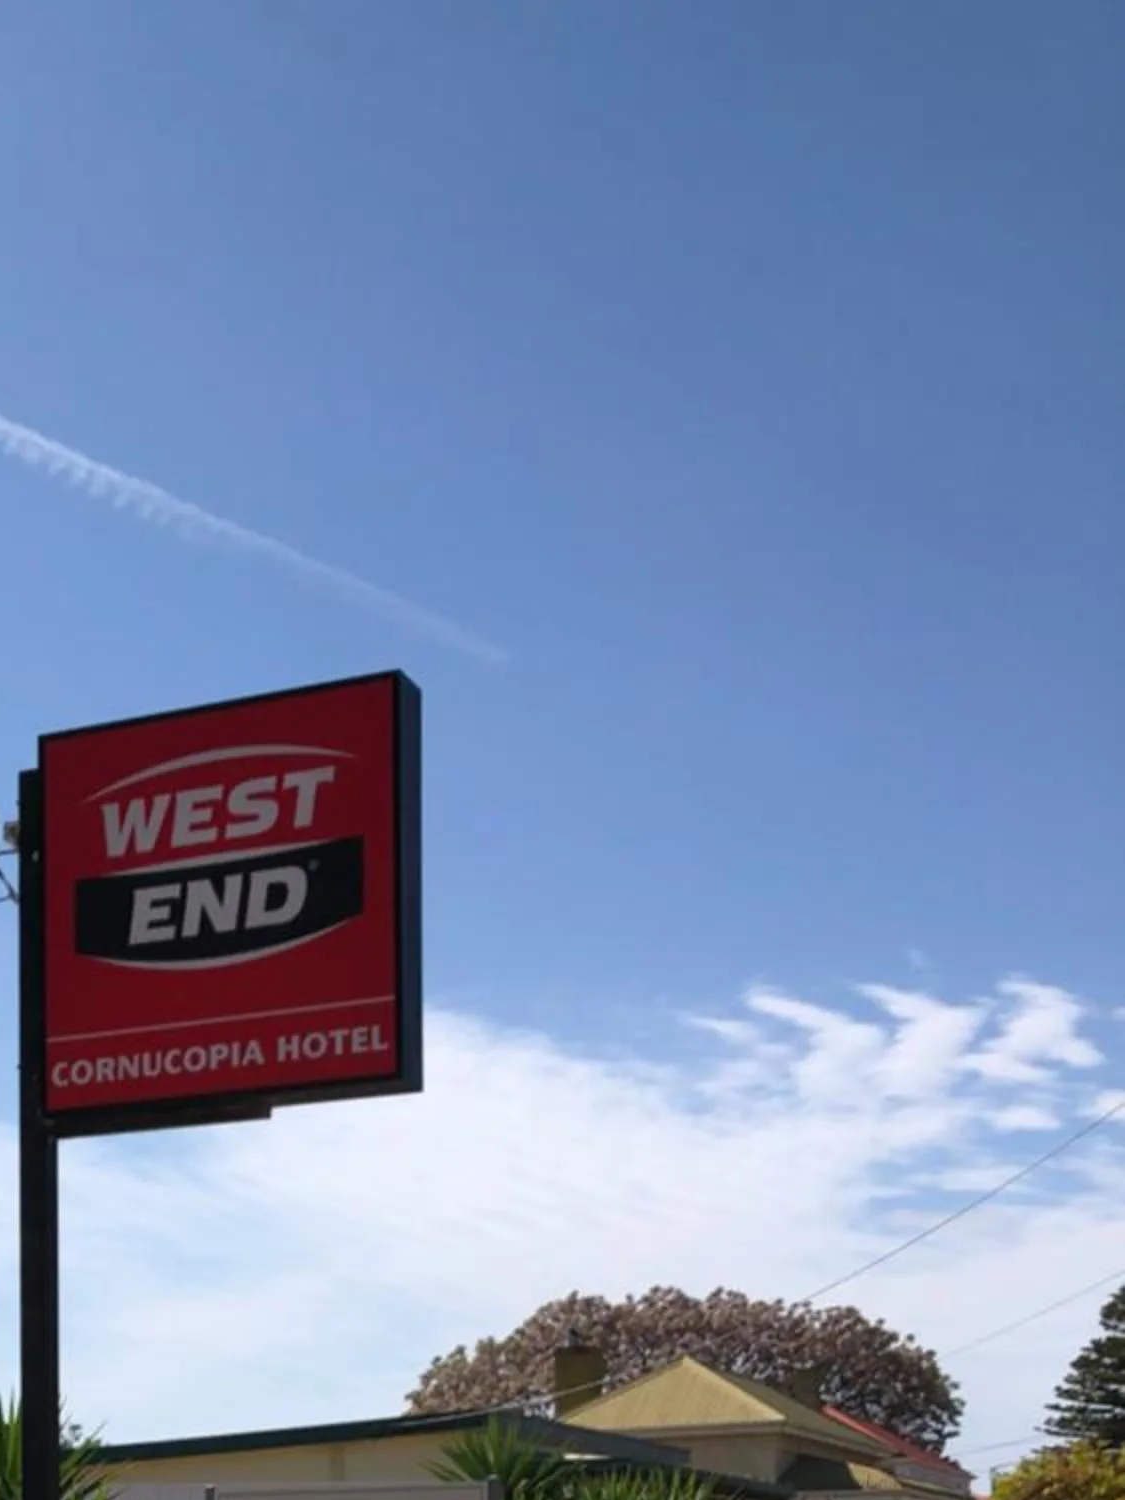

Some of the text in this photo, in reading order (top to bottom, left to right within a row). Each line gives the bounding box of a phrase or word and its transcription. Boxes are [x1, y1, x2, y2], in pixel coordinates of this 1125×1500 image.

[101, 765, 335, 858] WEST
[128, 866, 308, 946] END
[51, 1025, 388, 1087] CORNUCOPIA HOTEL
